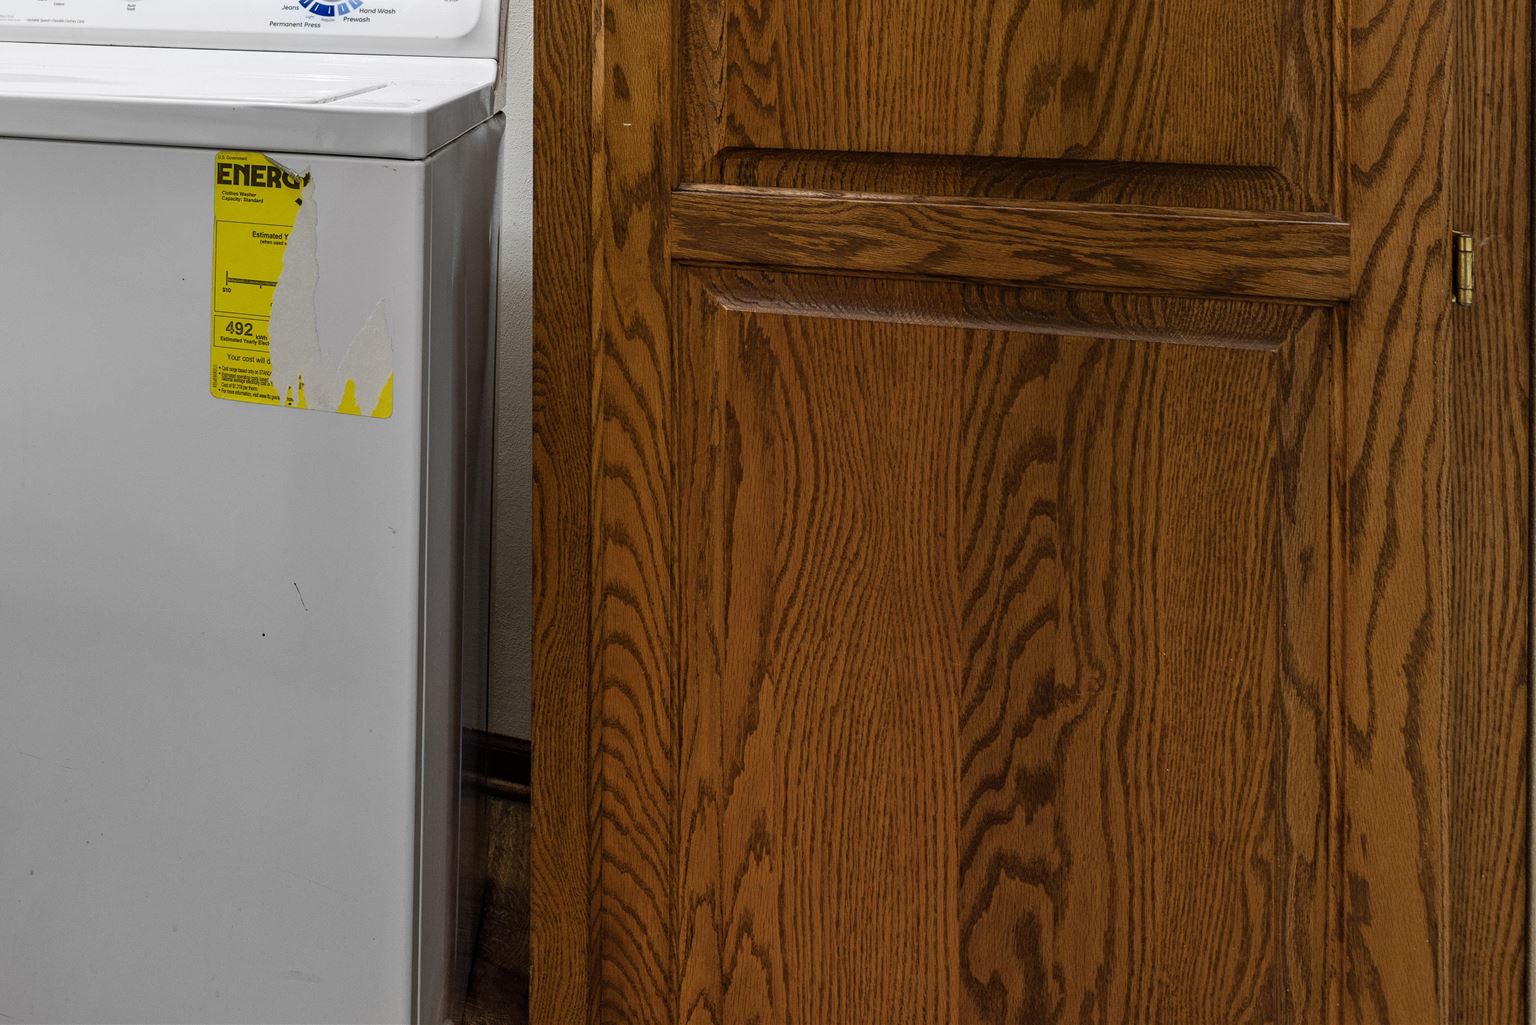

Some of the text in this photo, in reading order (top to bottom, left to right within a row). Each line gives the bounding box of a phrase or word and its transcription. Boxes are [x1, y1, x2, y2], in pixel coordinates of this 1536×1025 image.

[252, 230, 282, 240] Estimated
[225, 321, 253, 336] 492
[227, 353, 241, 361] Your
[242, 355, 255, 363] cost
